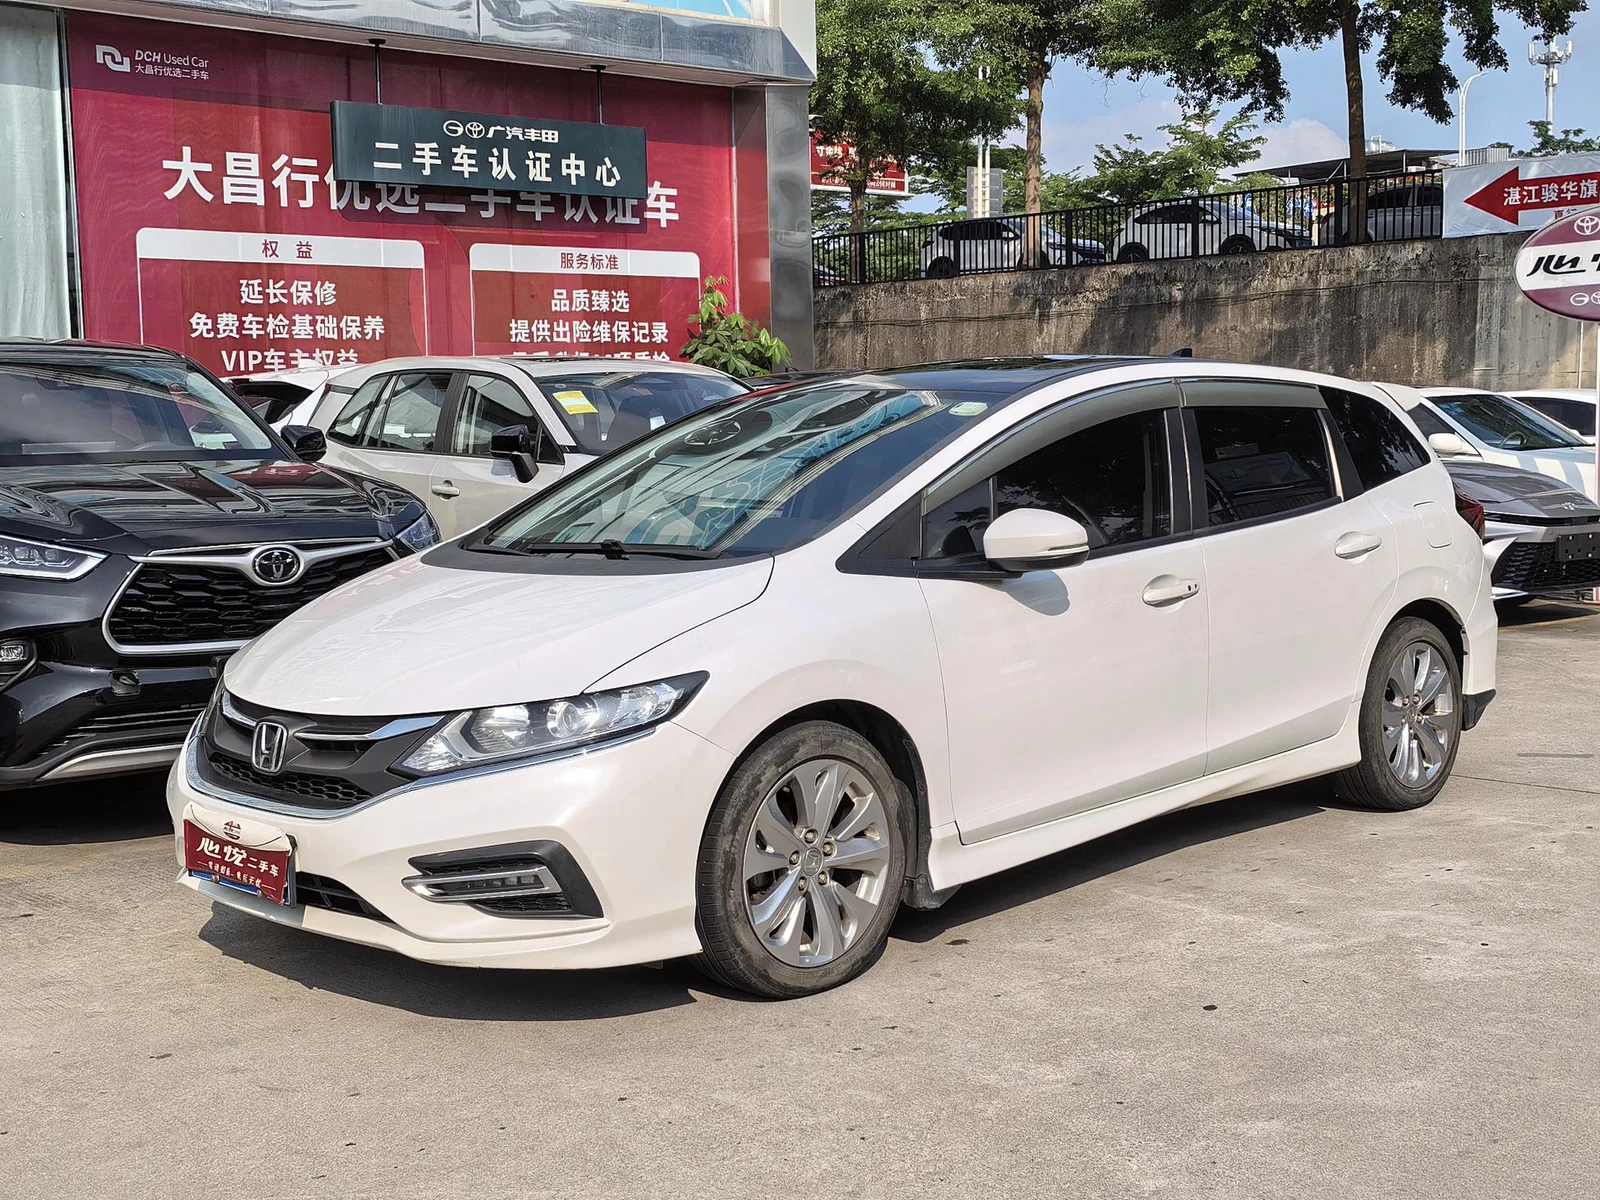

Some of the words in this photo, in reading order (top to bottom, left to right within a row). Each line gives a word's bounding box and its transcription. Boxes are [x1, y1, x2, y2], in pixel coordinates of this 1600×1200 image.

[135, 50, 161, 63] DCH
[163, 53, 189, 66] Used
[191, 56, 209, 68] Car
[135, 63, 209, 80] 大昌行优选二手车
[486, 126, 558, 143] 广汽丰田
[373, 142, 621, 187] 二手车认证中心
[1503, 179, 1598, 206] 湛江骏华旗
[262, 239, 313, 259] 权益
[560, 252, 619, 270] 服务标准
[1526, 254, 1600, 277] 心
[239, 279, 337, 306] 延长保修
[551, 289, 630, 313] 品质臻选
[189, 312, 385, 341] 免费车检基础保养
[509, 318, 669, 344] 提供出险维保记录
